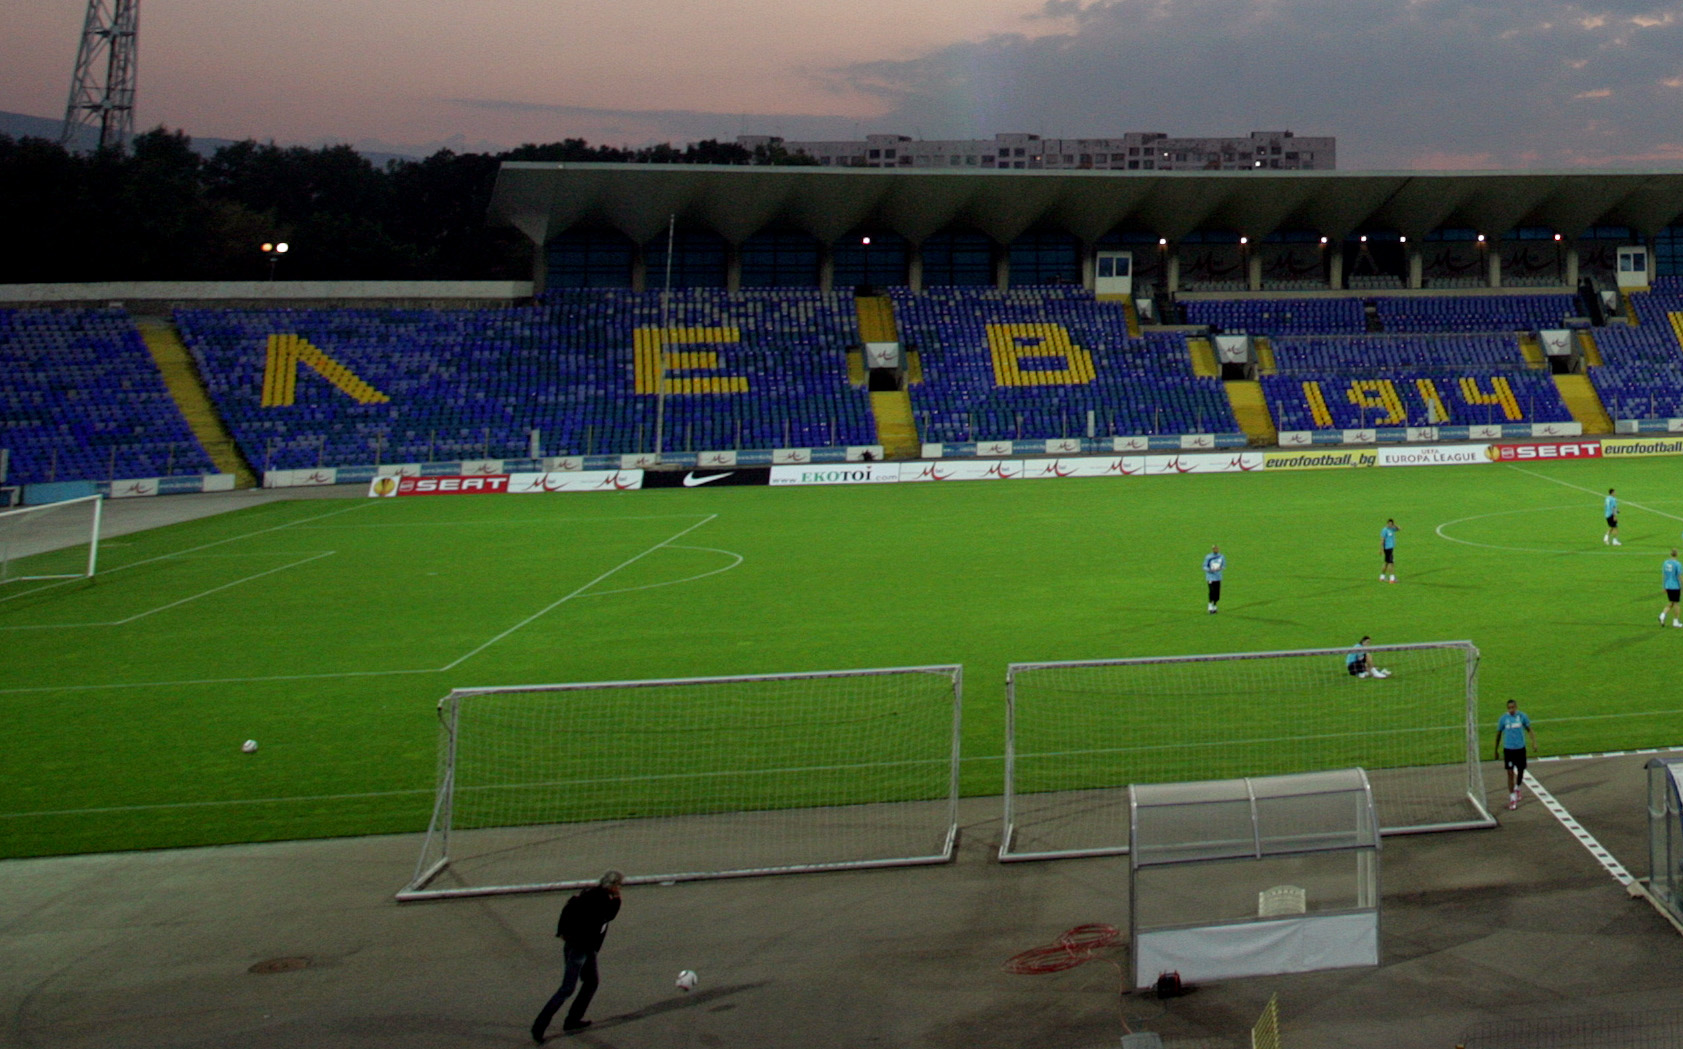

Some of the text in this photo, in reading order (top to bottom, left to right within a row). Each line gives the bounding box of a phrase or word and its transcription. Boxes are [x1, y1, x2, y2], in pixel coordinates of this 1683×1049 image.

[1386, 452, 1476, 463] EUROPA LEAGUE
[1517, 443, 1600, 458] SEAT
[415, 477, 508, 492] SEAT
